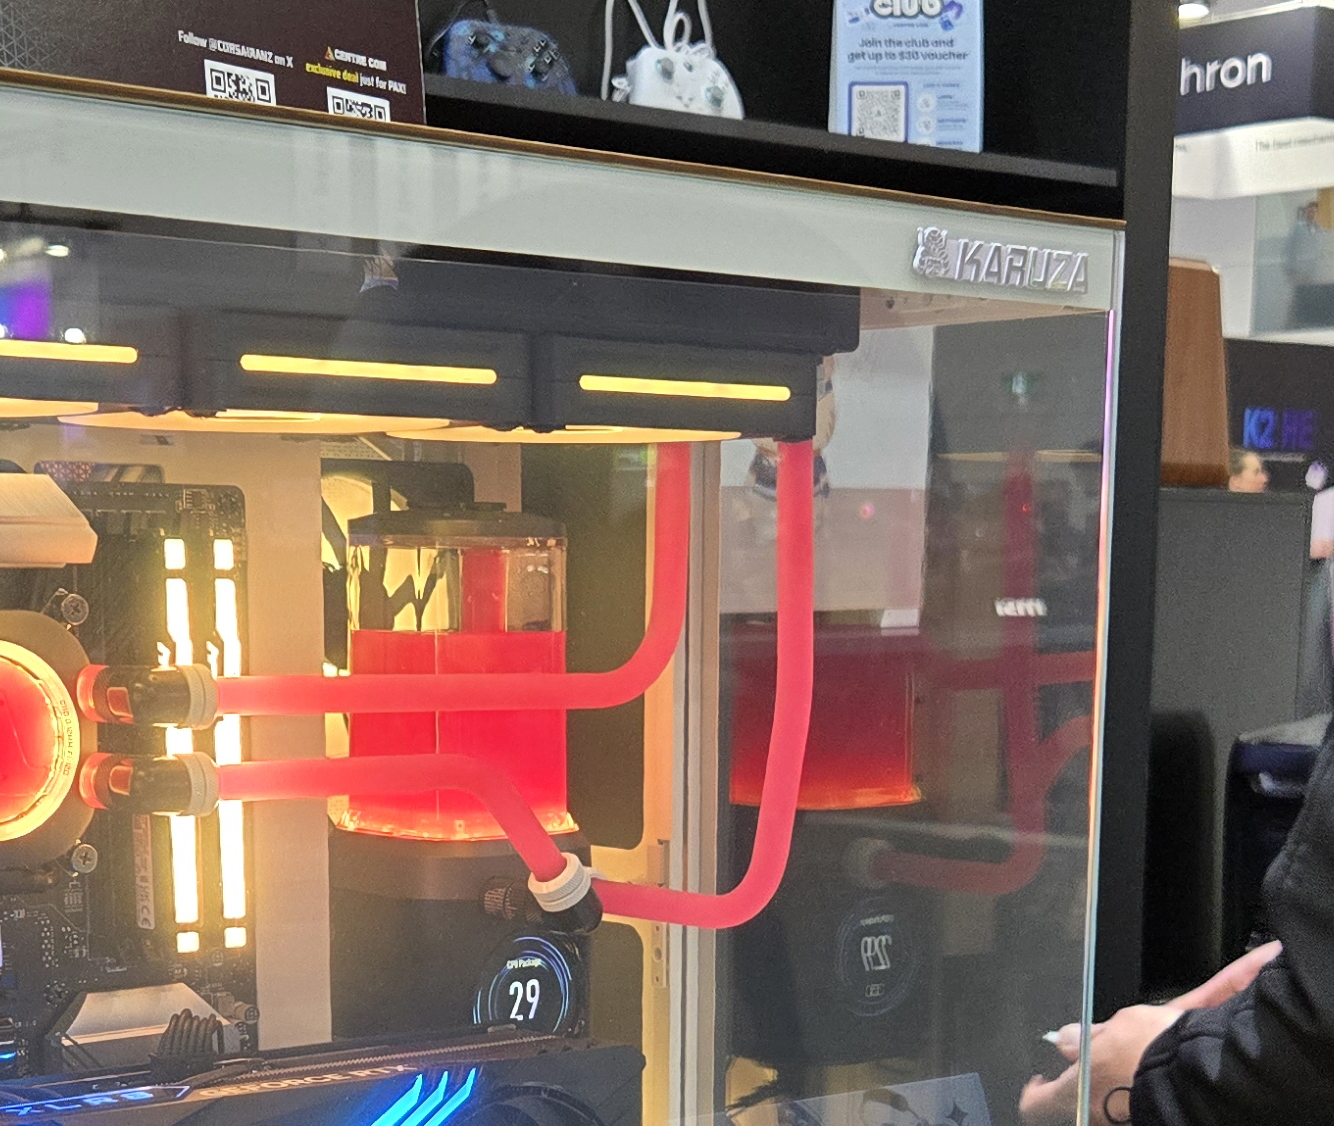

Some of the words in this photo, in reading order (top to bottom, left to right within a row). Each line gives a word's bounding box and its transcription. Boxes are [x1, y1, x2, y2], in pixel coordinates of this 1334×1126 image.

[178, 30, 207, 47] Follow
[274, 55, 285, 66] on
[286, 55, 294, 68] X
[868, 53, 883, 63] up
[922, 50, 968, 61] voucher
[884, 38, 903, 48] the
[930, 37, 954, 48] and
[334, 48, 367, 67] CENTRE
[368, 57, 387, 71] COM
[306, 62, 341, 79] exclusive
[342, 69, 359, 83] deal
[359, 73, 375, 87] just
[375, 76, 387, 89] for
[388, 80, 407, 95] PAX!
[954, 238, 1089, 294] KARUZA
[509, 978, 540, 1021] 29
[199, 1073, 351, 1098] GEFORCE
[353, 1064, 419, 1078] RTX
[5, 1090, 154, 1116] XLR8
